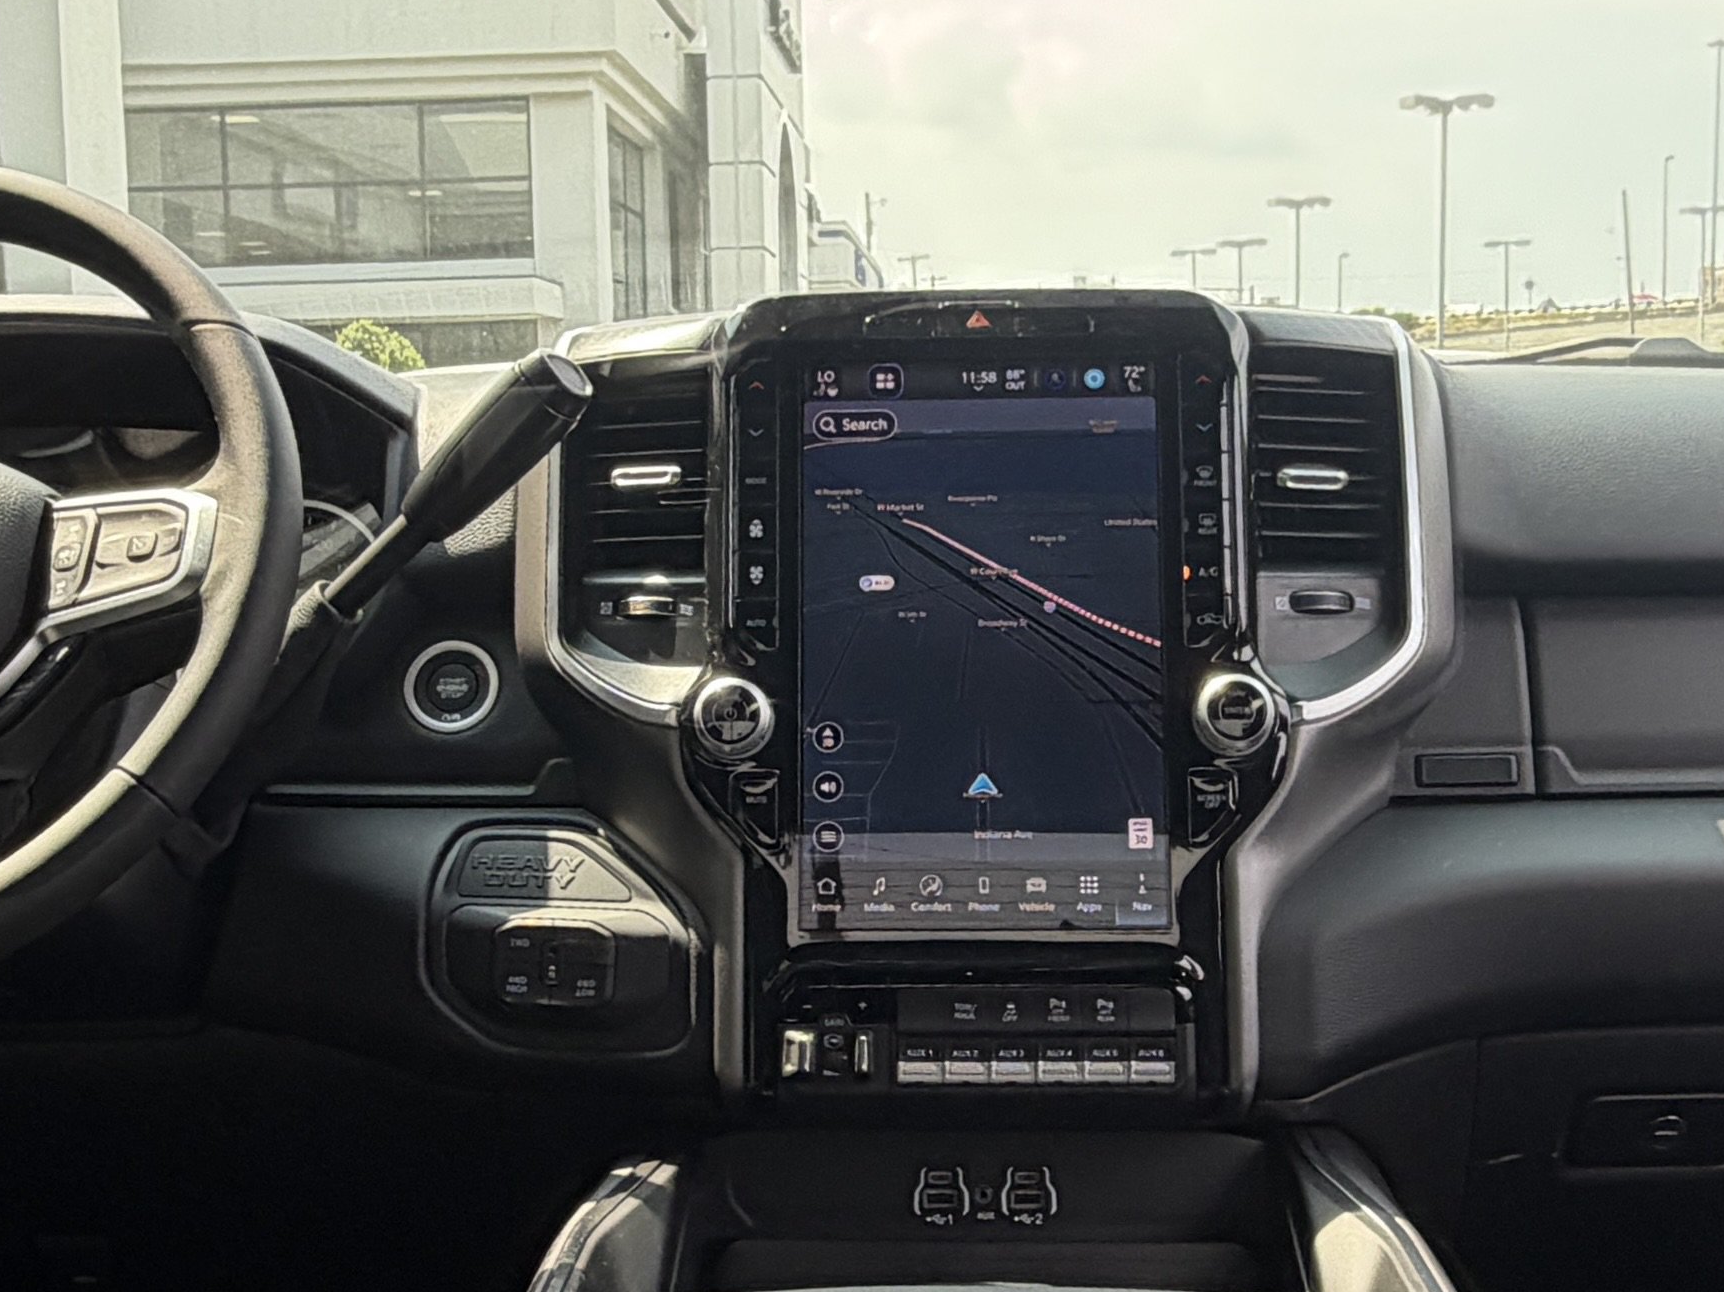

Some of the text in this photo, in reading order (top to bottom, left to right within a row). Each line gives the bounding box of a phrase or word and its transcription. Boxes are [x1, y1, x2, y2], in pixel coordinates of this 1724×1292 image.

[818, 370, 836, 383] LO
[961, 370, 998, 385] 11:58
[841, 417, 889, 432] Search
[471, 854, 586, 873] HEAVY
[483, 871, 577, 890] DUTY
